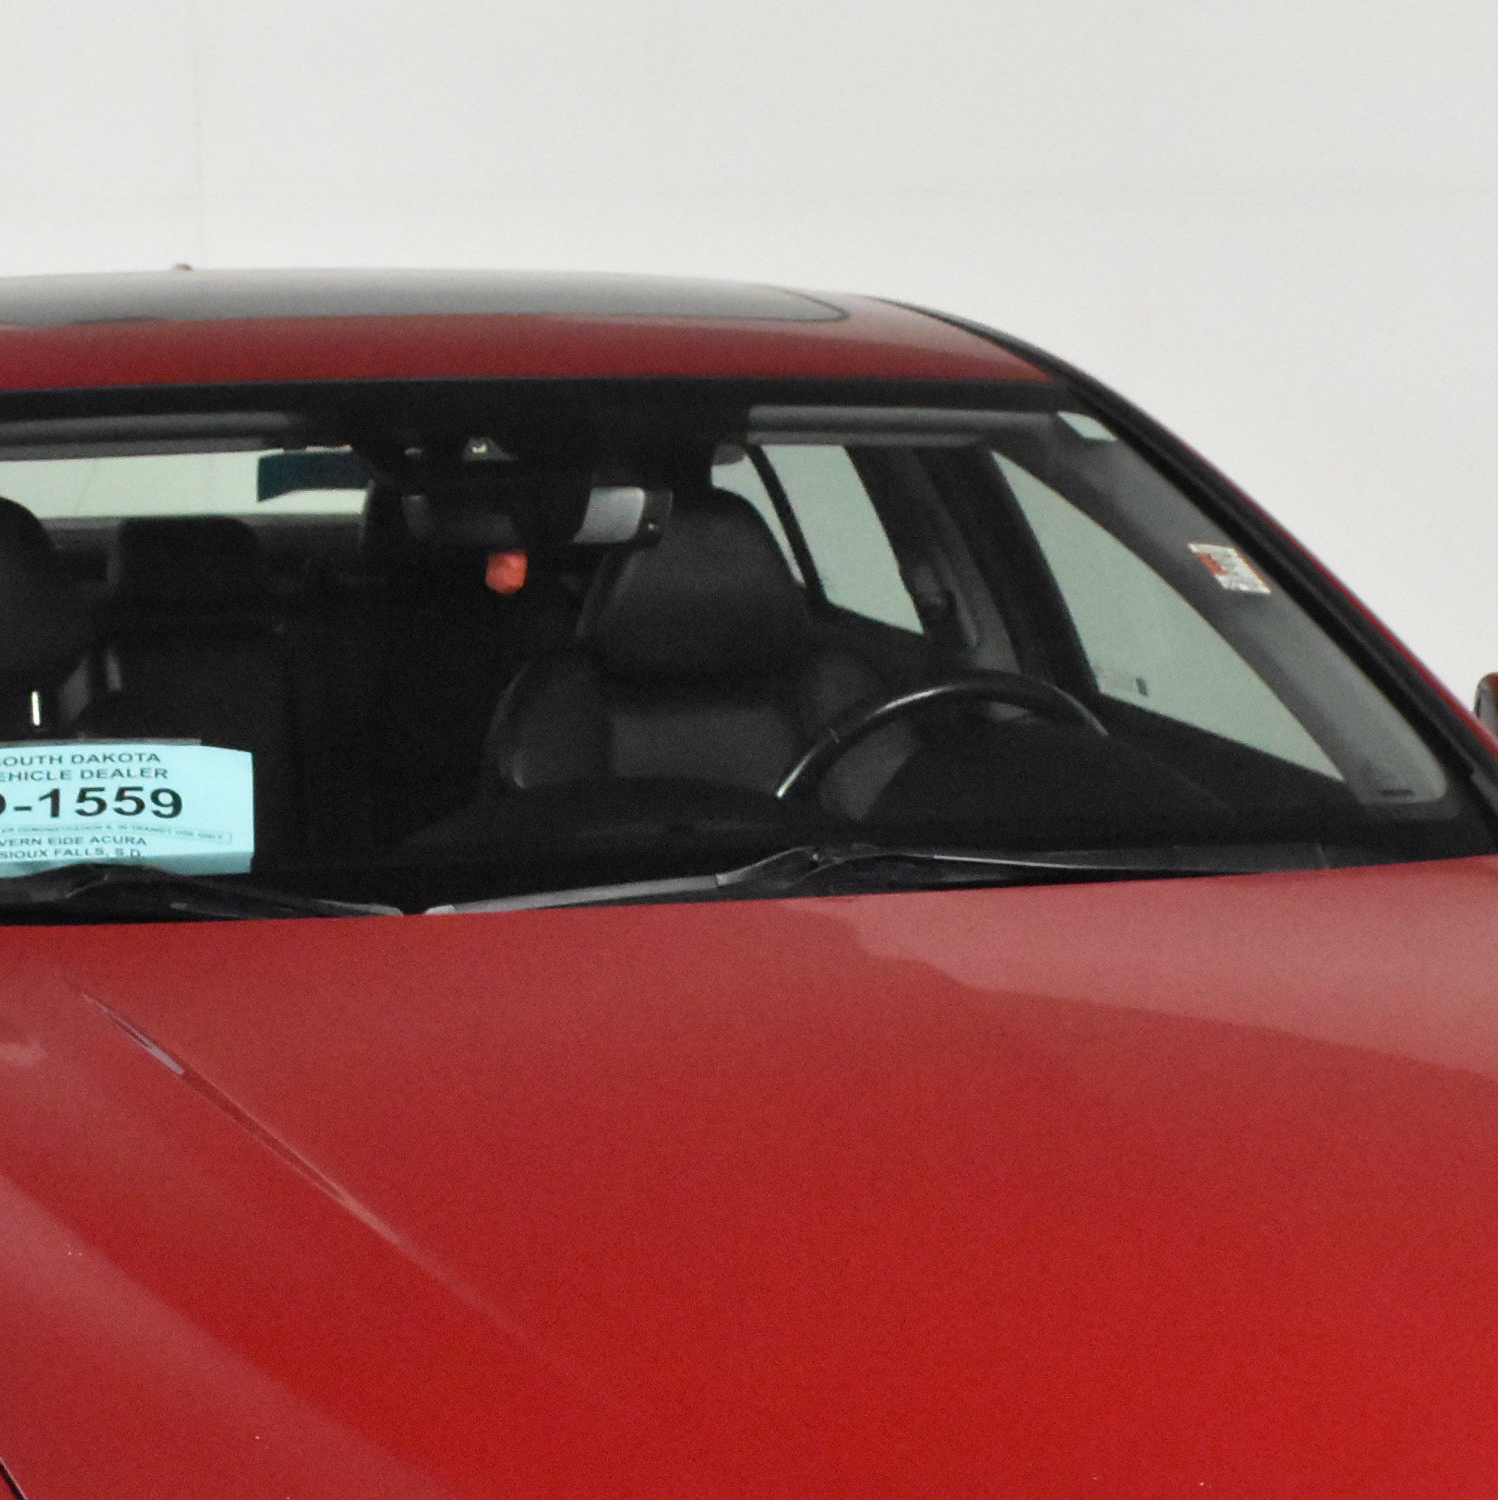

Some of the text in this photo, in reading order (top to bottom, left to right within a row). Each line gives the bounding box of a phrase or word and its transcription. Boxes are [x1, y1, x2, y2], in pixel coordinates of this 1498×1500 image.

[70, 752, 161, 765] DAKOTA
[80, 768, 168, 781] DEALER
[90, 836, 147, 846] ACURA
